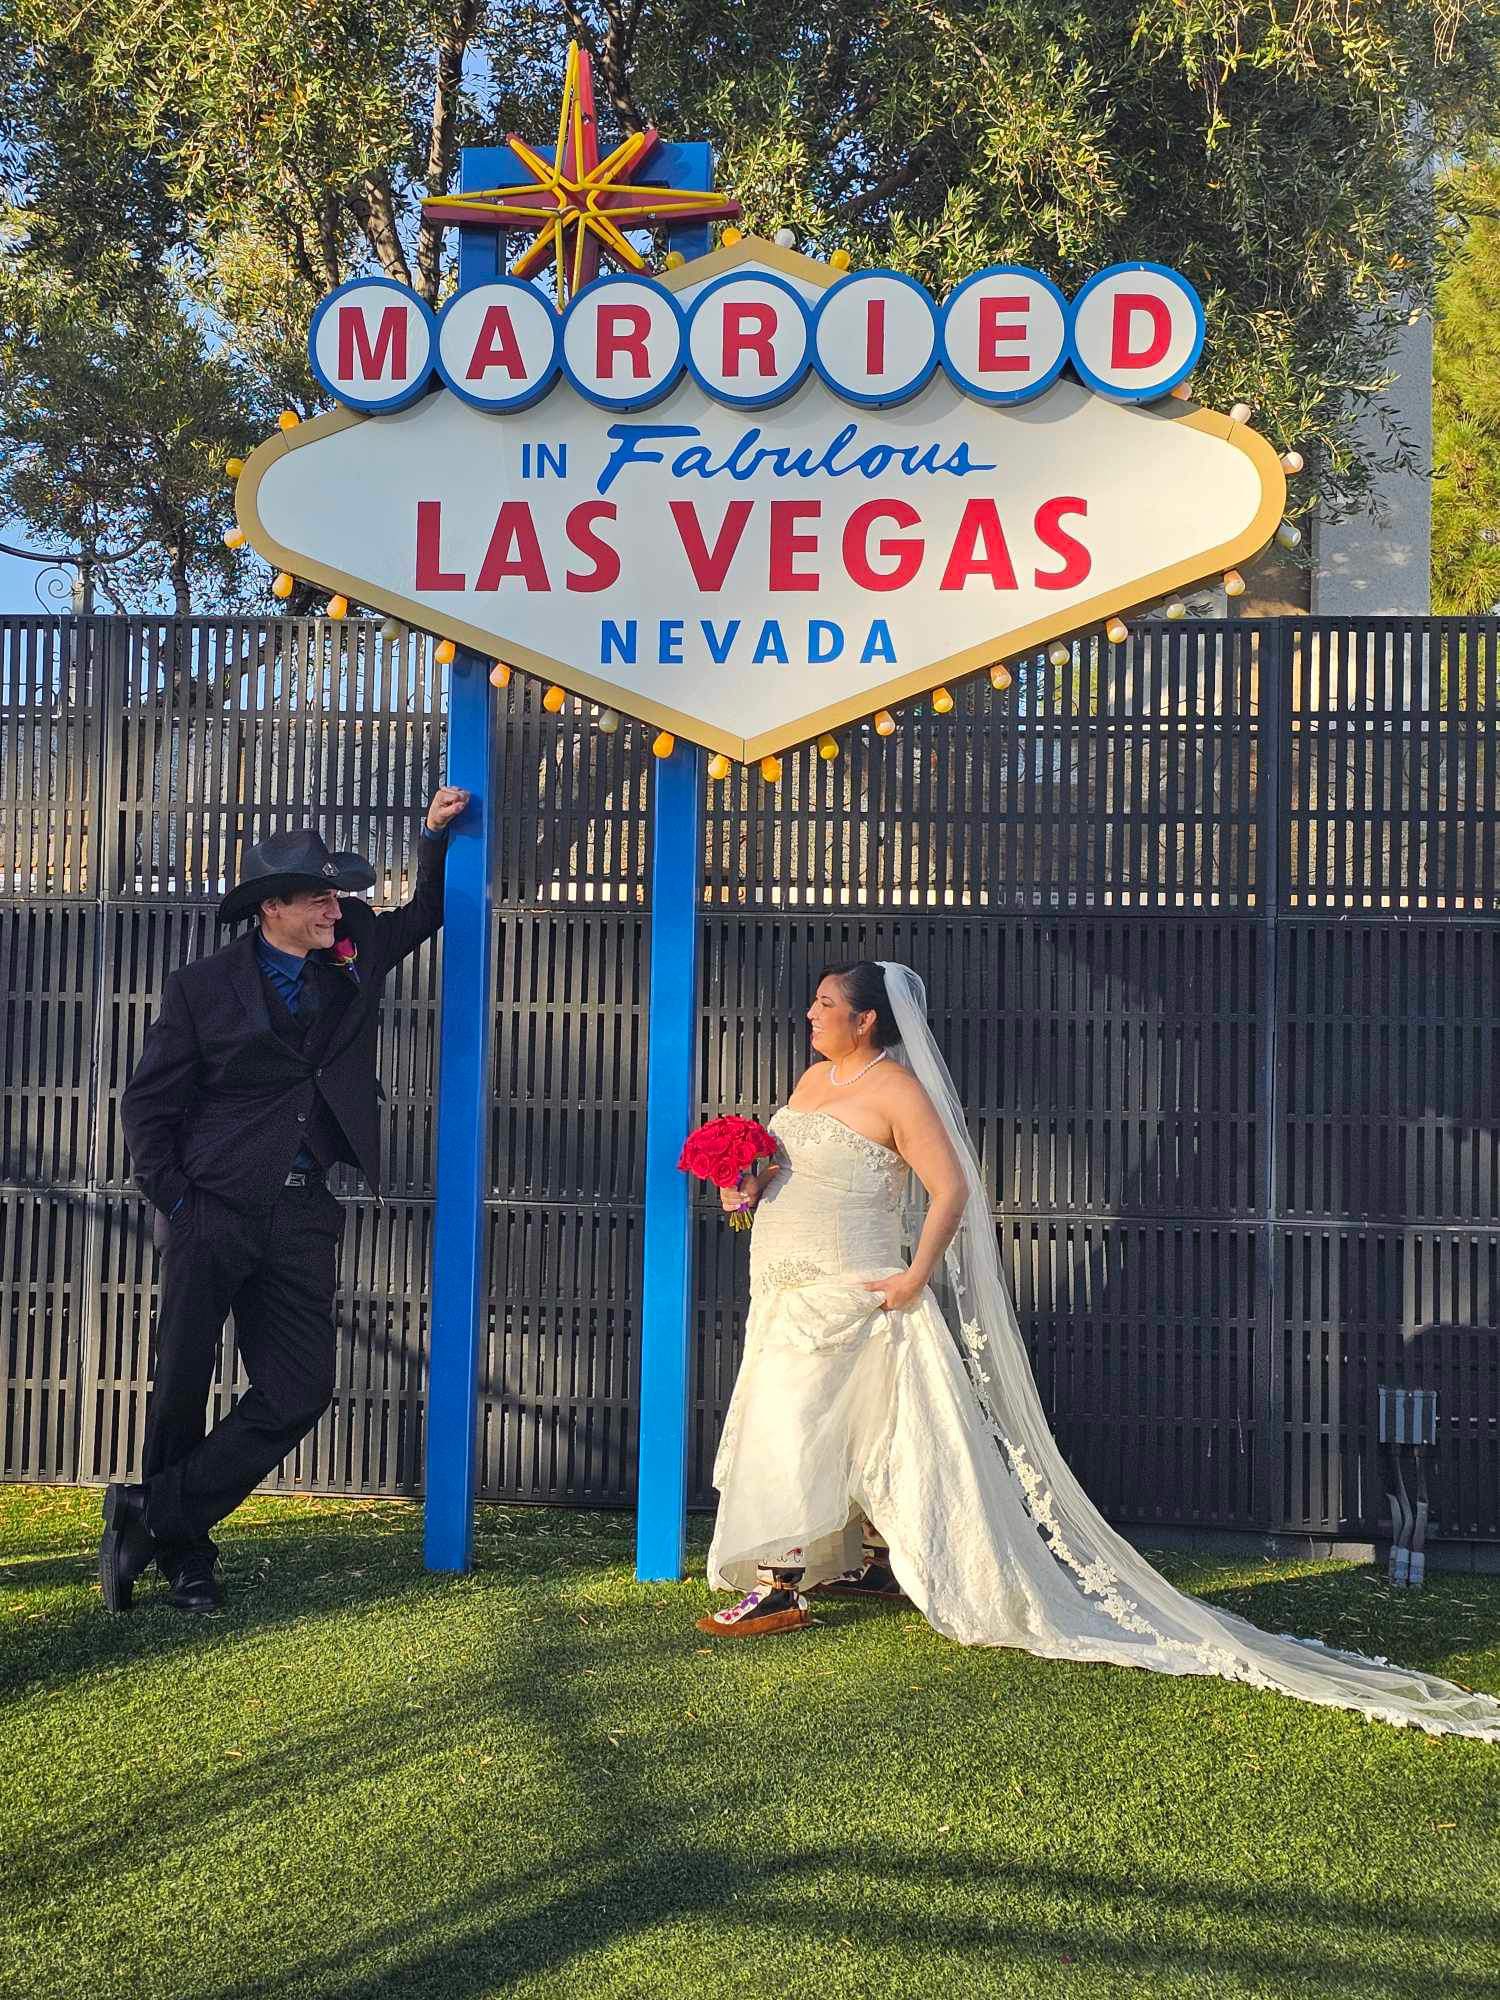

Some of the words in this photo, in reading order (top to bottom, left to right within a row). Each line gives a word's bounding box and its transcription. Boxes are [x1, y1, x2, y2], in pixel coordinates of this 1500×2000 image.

[338, 294, 1172, 381] MARRIED
[521, 443, 567, 479] IN
[597, 423, 996, 496] Fabulous
[415, 500, 622, 592] LAS
[669, 496, 1092, 592] VEGAS
[600, 619, 898, 665] NEVADA
